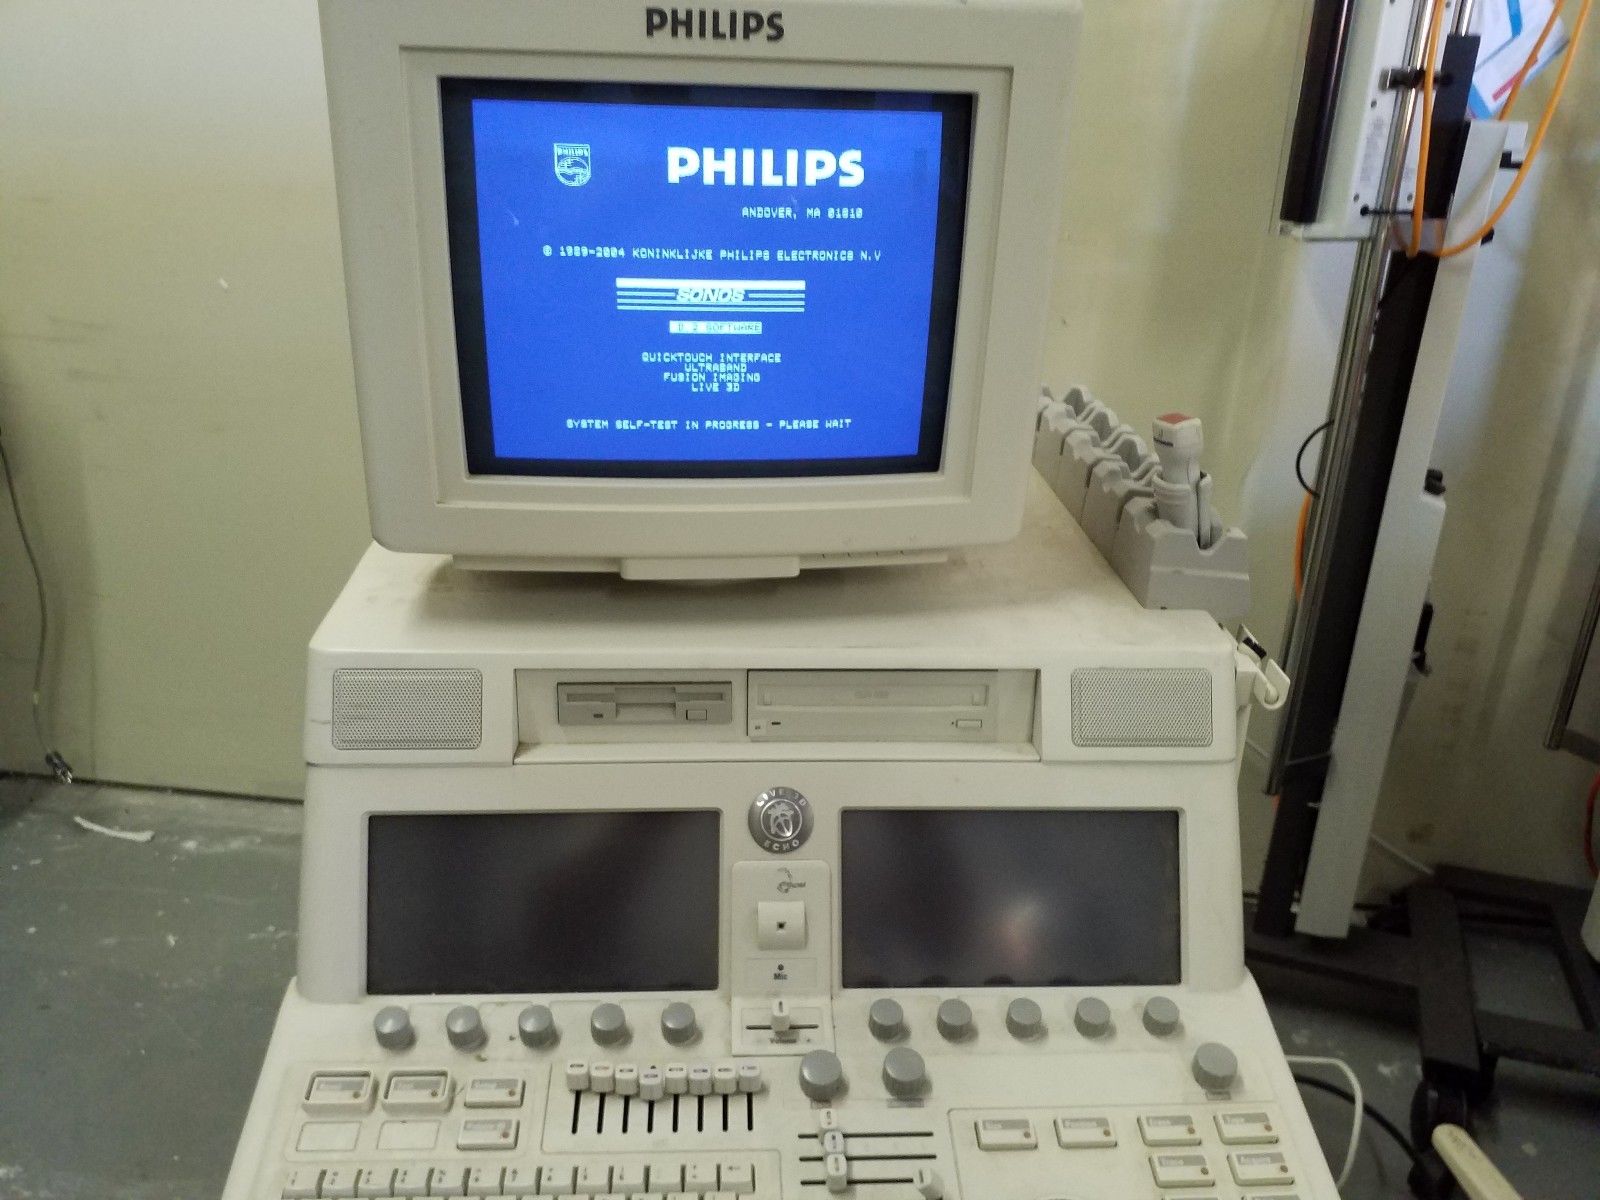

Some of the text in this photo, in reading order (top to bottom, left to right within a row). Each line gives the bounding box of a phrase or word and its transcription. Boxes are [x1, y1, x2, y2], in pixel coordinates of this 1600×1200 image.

[646, 7, 785, 42] PHILIPS
[666, 145, 865, 188] PHILIPS
[741, 206, 797, 220] ANDOVER,
[806, 207, 821, 219] MA
[632, 247, 713, 261] KONINKLIJKE
[719, 249, 770, 262] PHILIPS
[776, 249, 854, 262] ELECTRONICS
[675, 287, 746, 303] SONOS
[641, 351, 782, 364] QUICKTOUCH INTERFACE
[684, 362, 748, 373] ULTRABAND
[663, 372, 761, 383] FUSION IMAGING
[691, 382, 741, 393] LIVE 3D
[566, 418, 609, 430] SYSTEM
[615, 419, 678, 430] SELF-TEST
[685, 419, 699, 430] IN
[705, 419, 760, 430] PROGRESS
[778, 419, 820, 430] PLEASE
[825, 418, 852, 429] WAIT
[763, 838, 801, 853] ECHO
[773, 972, 789, 981] Mic
